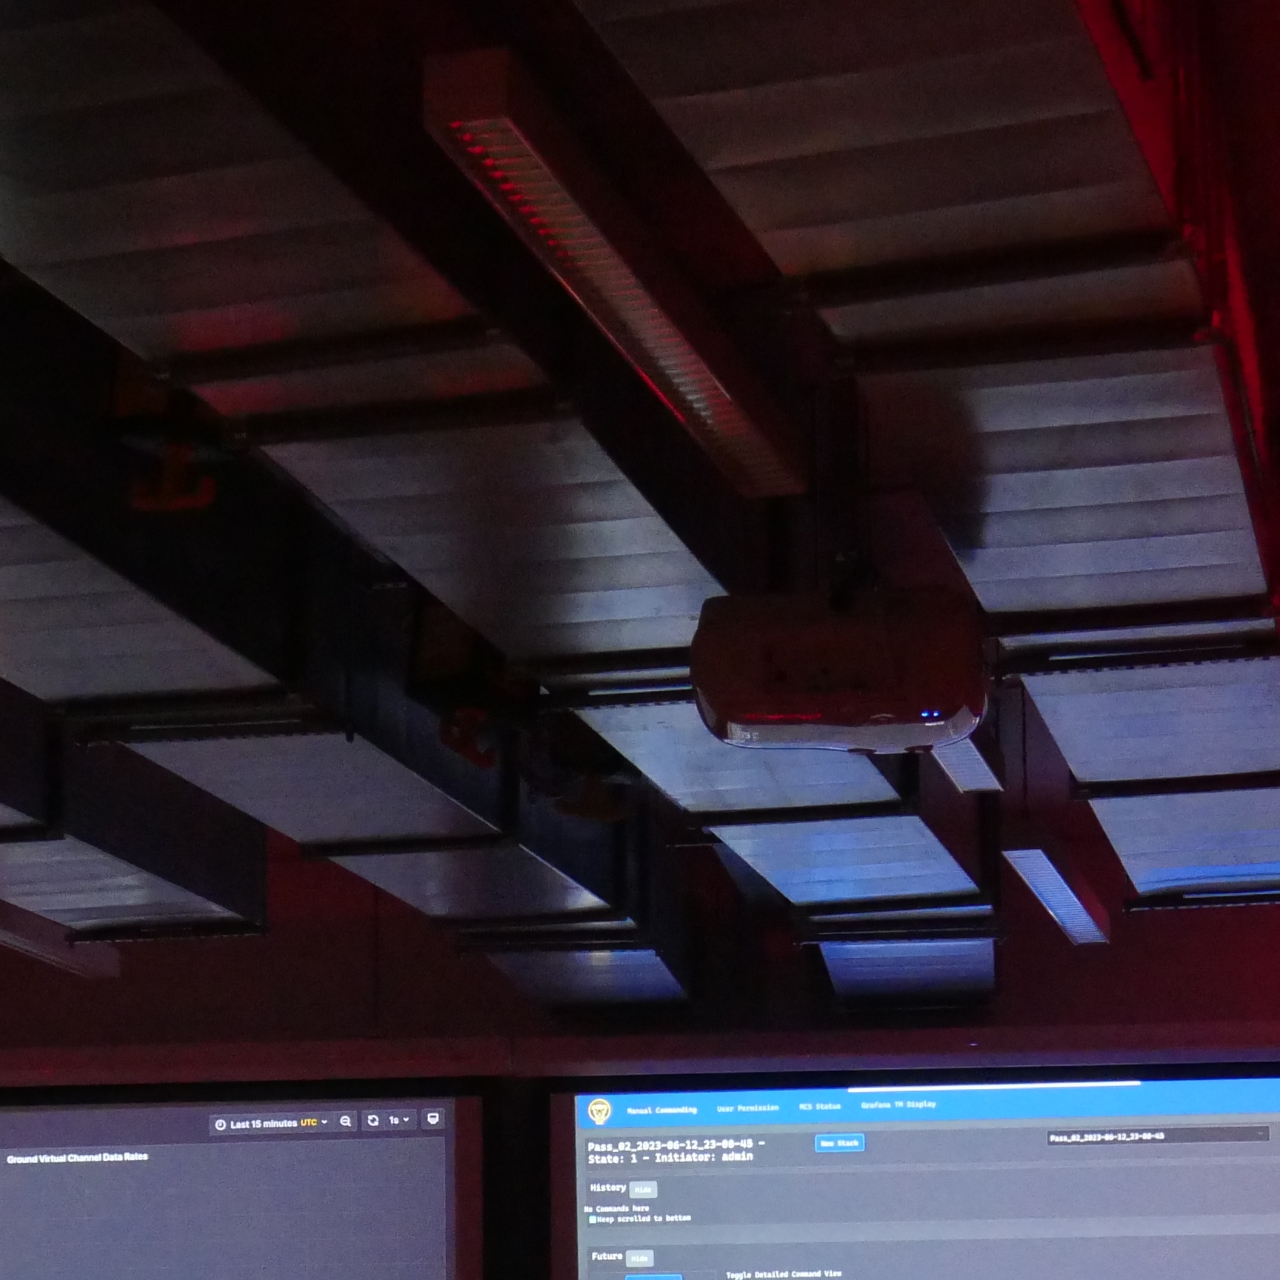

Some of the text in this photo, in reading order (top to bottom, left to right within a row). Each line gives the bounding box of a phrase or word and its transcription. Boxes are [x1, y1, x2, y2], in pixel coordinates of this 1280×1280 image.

[627, 1106, 697, 1115] Manual Commanding
[717, 1104, 779, 1113] User Permission
[800, 1102, 841, 1111] MCS Status
[861, 1101, 891, 1111] Grafana
[907, 1100, 936, 1109] Display
[230, 1118, 317, 1129] Last 15 minutes UTC
[389, 1116, 398, 1124] 1s
[7, 1152, 149, 1164] Ground Virtual Channel Data Rates
[589, 1150, 753, 1164] State: 1 Initiator: admin
[590, 1182, 651, 1194] History Hide
[584, 1204, 649, 1213] No Commands here
[617, 1214, 649, 1223] scrolled
[652, 1214, 661, 1222] to
[664, 1214, 691, 1222] bottom
[592, 1251, 648, 1263] Future Hide
[727, 1269, 842, 1280] Toggle Detailed Command View
